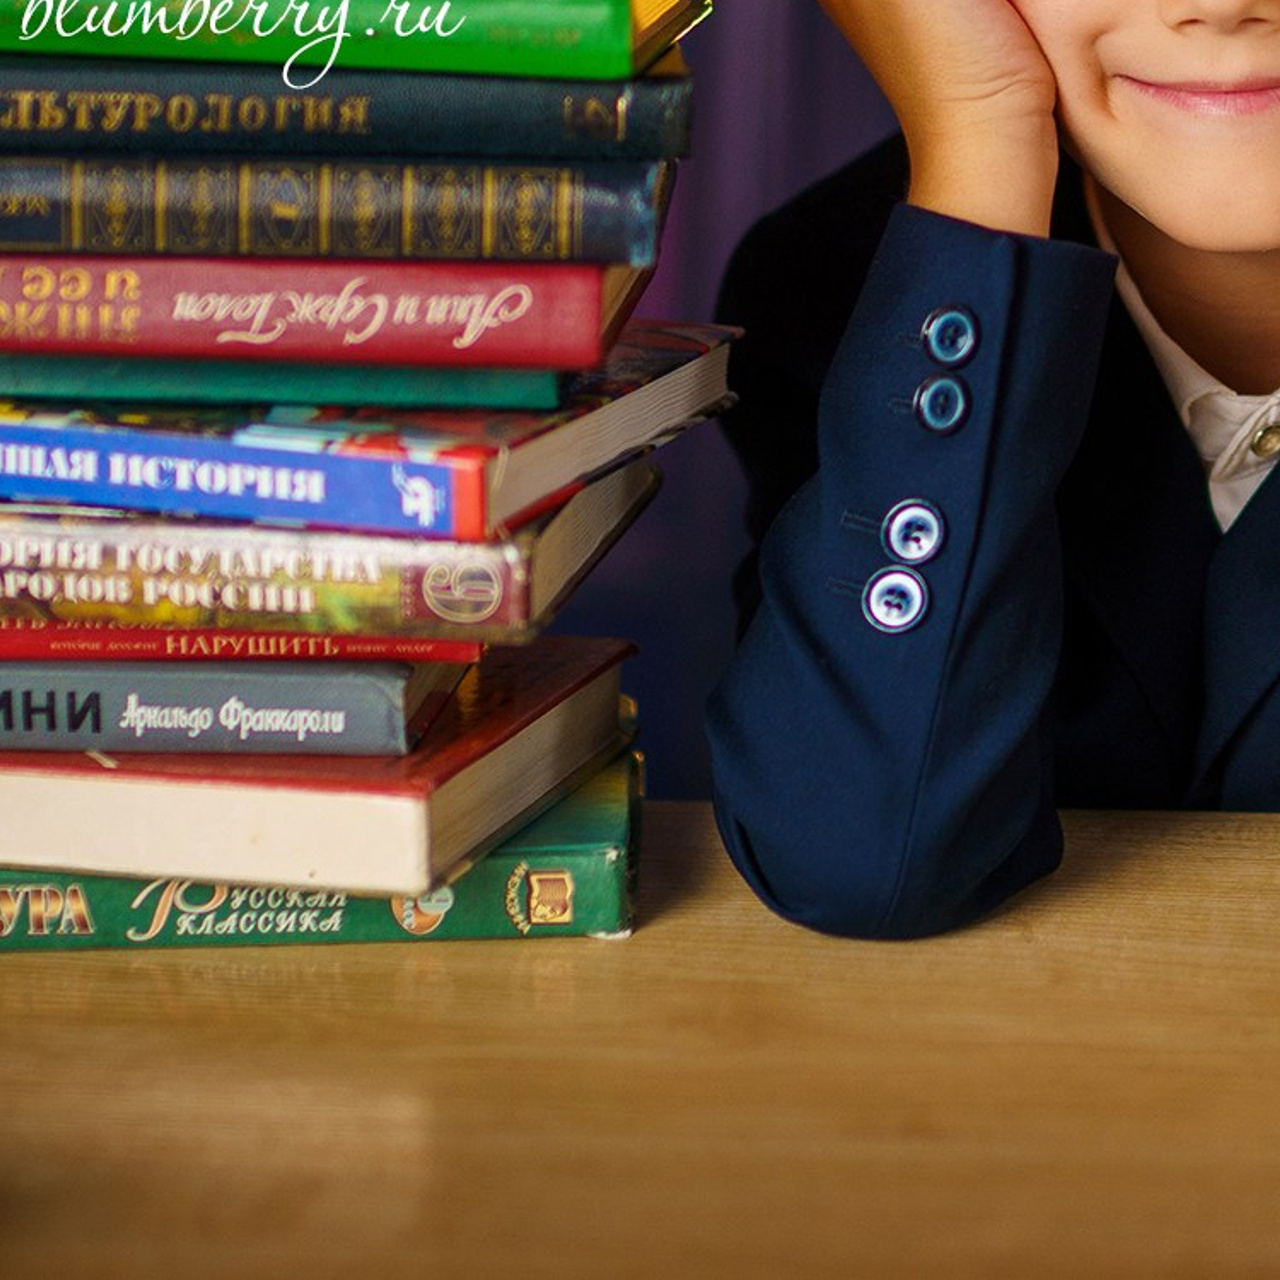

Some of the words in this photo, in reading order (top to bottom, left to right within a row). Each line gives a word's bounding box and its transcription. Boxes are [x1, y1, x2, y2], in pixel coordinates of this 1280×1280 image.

[287, 277, 389, 345] Серж
[394, 293, 419, 325] и
[0, 443, 98, 482] ШАЯ
[108, 451, 325, 504] ИСТОРИЯ
[116, 542, 382, 583] ГОСУДАРСТВА
[142, 579, 314, 613] РОССИИ
[166, 635, 339, 657] НАРУШИТЬ
[120, 693, 213, 737] Арнальдо
